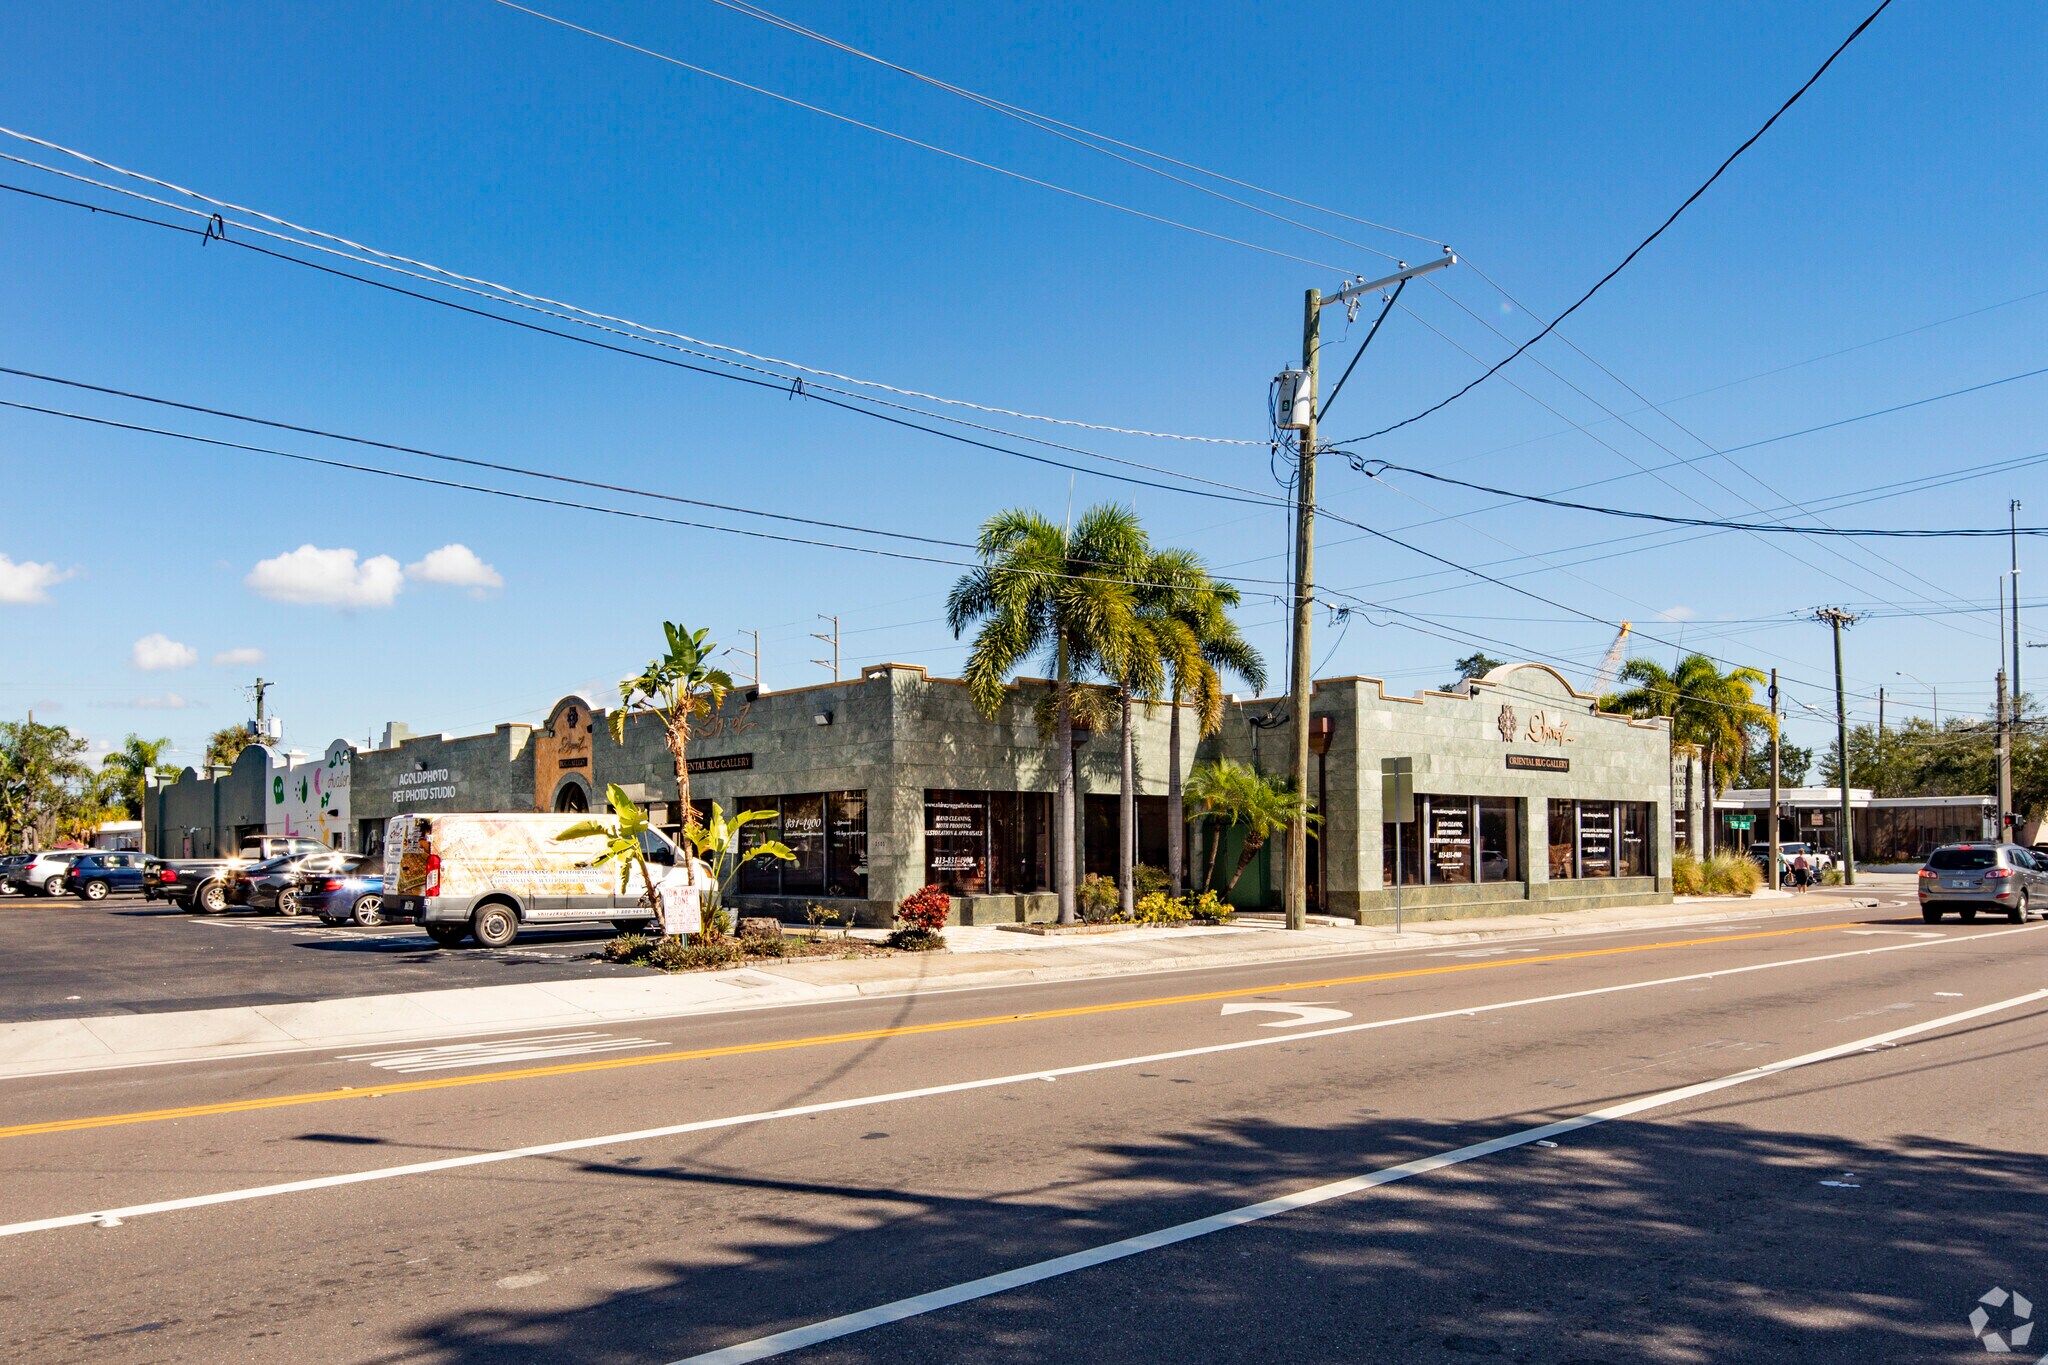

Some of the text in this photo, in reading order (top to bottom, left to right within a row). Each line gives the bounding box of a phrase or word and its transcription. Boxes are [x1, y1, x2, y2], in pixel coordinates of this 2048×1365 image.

[707, 759, 720, 769] RUG
[720, 757, 751, 768] GALLERY
[1509, 756, 1568, 768] ORIENTAL RUG GALLERY
[398, 768, 449, 786] AGOLDPHOTO
[392, 785, 456, 803] PET PHOTO STUDIO
[665, 888, 678, 897] TOW
[673, 897, 689, 906] ZONE
